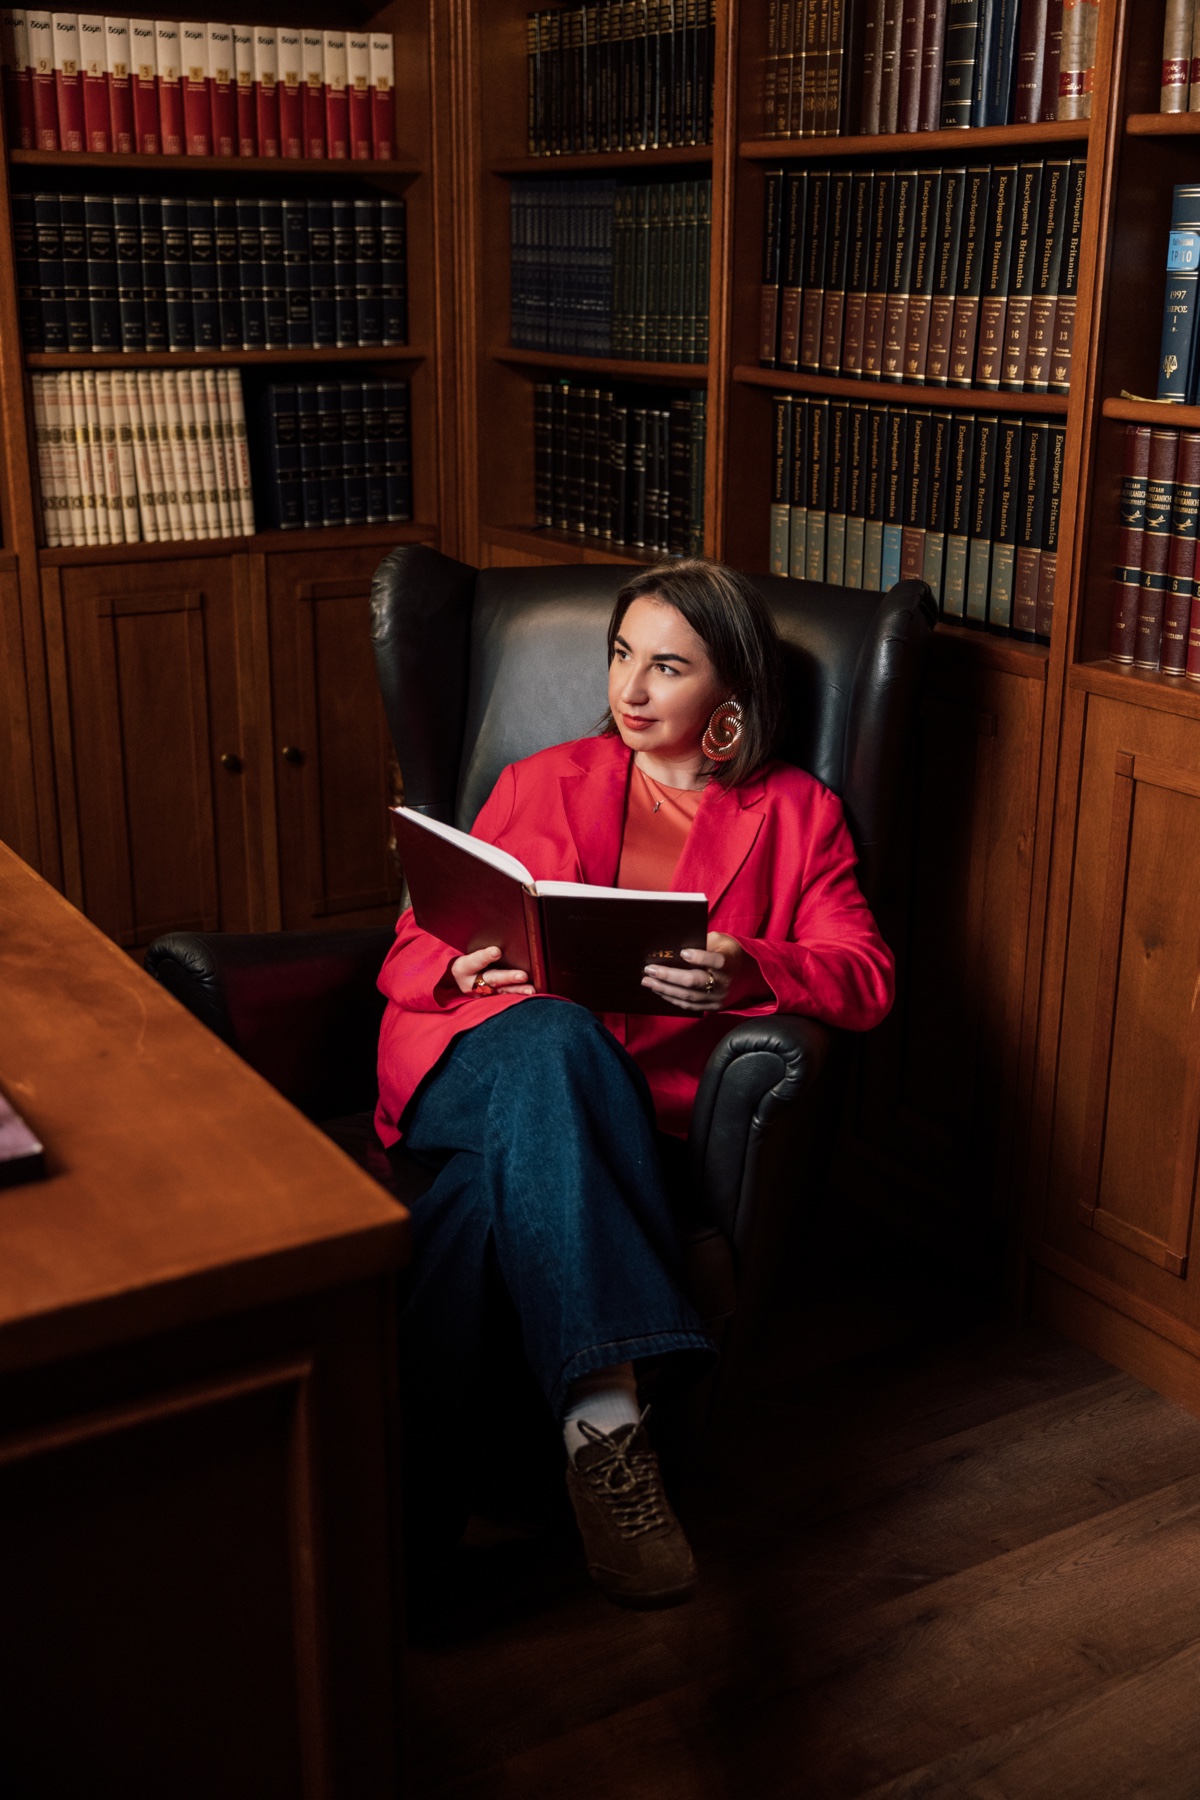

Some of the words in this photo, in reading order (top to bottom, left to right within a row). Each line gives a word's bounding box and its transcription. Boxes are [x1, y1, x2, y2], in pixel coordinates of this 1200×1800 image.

[40, 59, 47, 71] 9
[64, 61, 75, 73] 15
[91, 62, 98, 74] 4
[114, 64, 126, 76] 14
[168, 68, 174, 79] 4
[990, 241, 1003, 290] Britannica
[1015, 239, 1028, 289] Britannica
[1040, 238, 1053, 289] Britannica
[1066, 237, 1079, 289] Britannica
[1169, 290, 1187, 300] 1997
[958, 329, 968, 339] 17
[985, 329, 995, 339] 15
[1010, 329, 1020, 339] 16
[1034, 330, 1044, 340] 12
[1059, 330, 1069, 341] 13
[952, 484, 963, 530] Britannica
[974, 486, 986, 534] Britannica
[998, 490, 1010, 538] Britannica
[1023, 493, 1035, 542] Britannica
[1047, 497, 1060, 546] Britannica
[1122, 569, 1128, 582] 1
[1144, 575, 1151, 587] 4
[1172, 579, 1179, 591] 6
